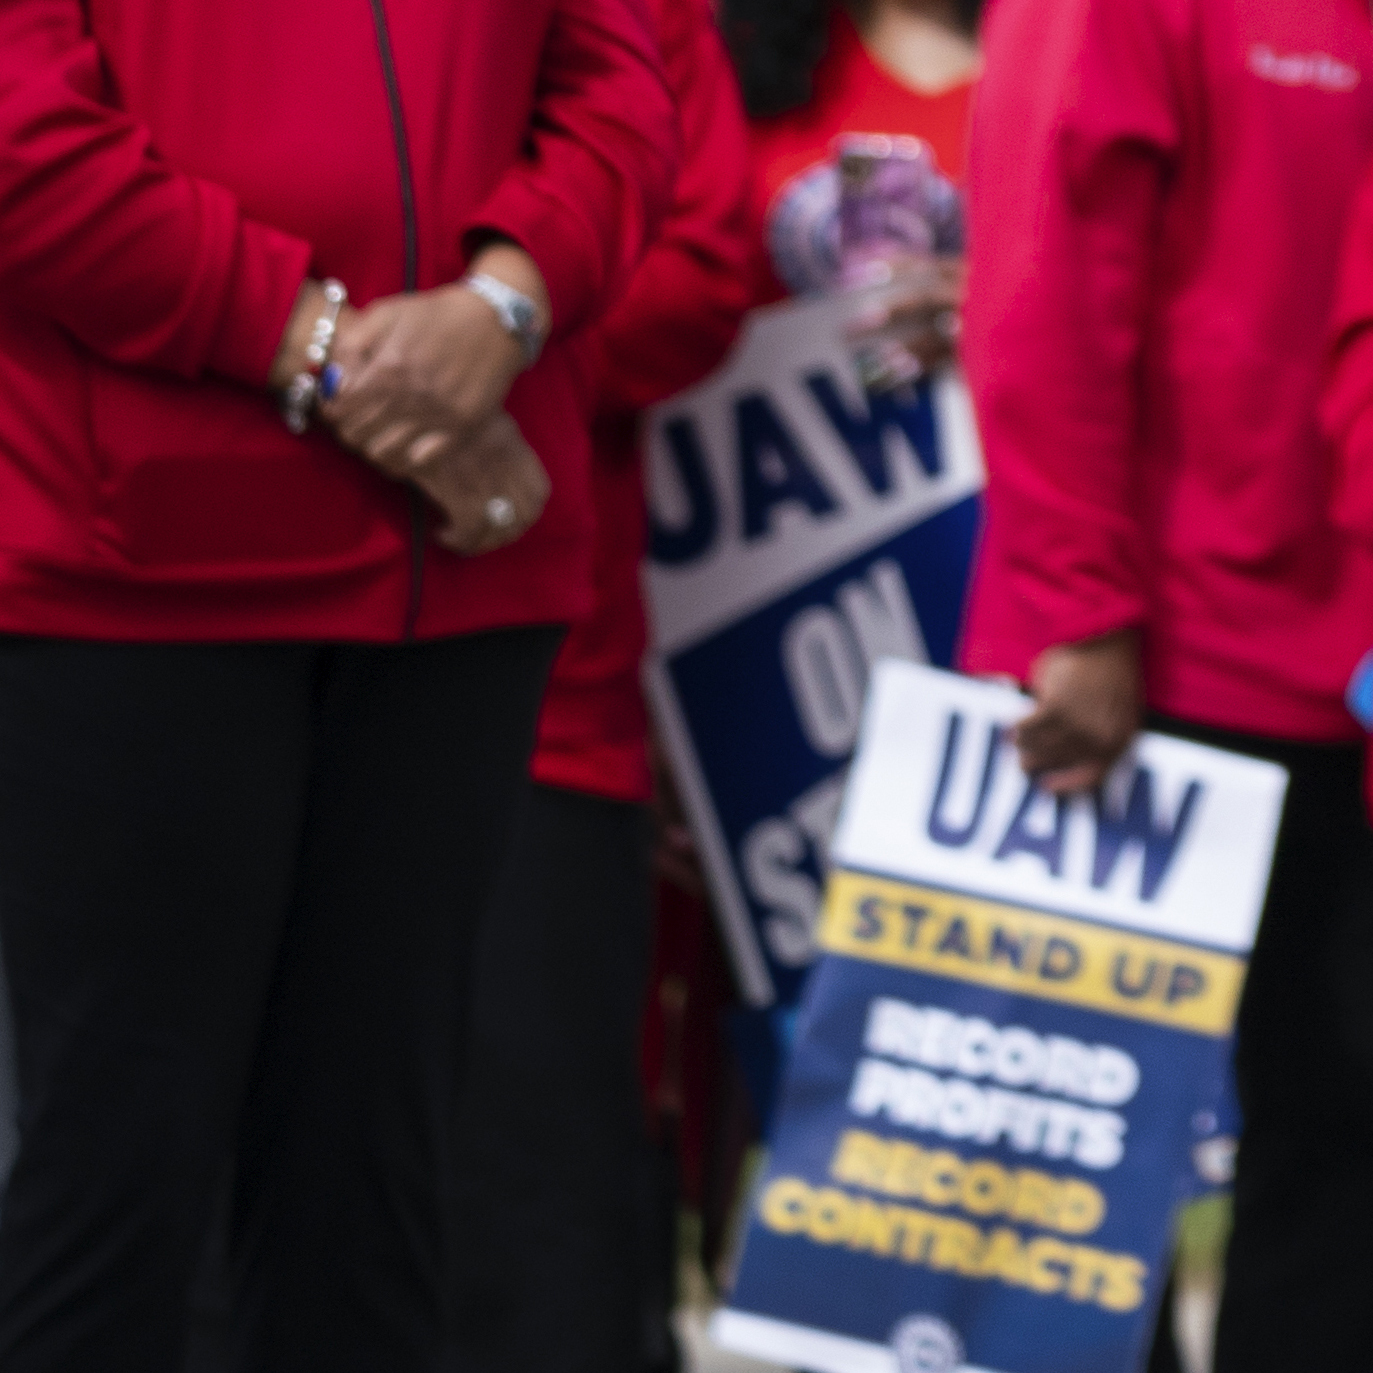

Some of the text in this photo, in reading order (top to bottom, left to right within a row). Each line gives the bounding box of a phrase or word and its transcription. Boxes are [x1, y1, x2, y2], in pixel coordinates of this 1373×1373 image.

[646, 365, 947, 571] UAW
[926, 707, 1208, 904] UAW
[850, 893, 1211, 1010] STAND UP
[865, 994, 1140, 1107] RECORD
[849, 1057, 1130, 1170] PROFITS
[831, 1129, 1107, 1236] RECORD
[760, 1177, 1148, 1313] CONTRACTS
